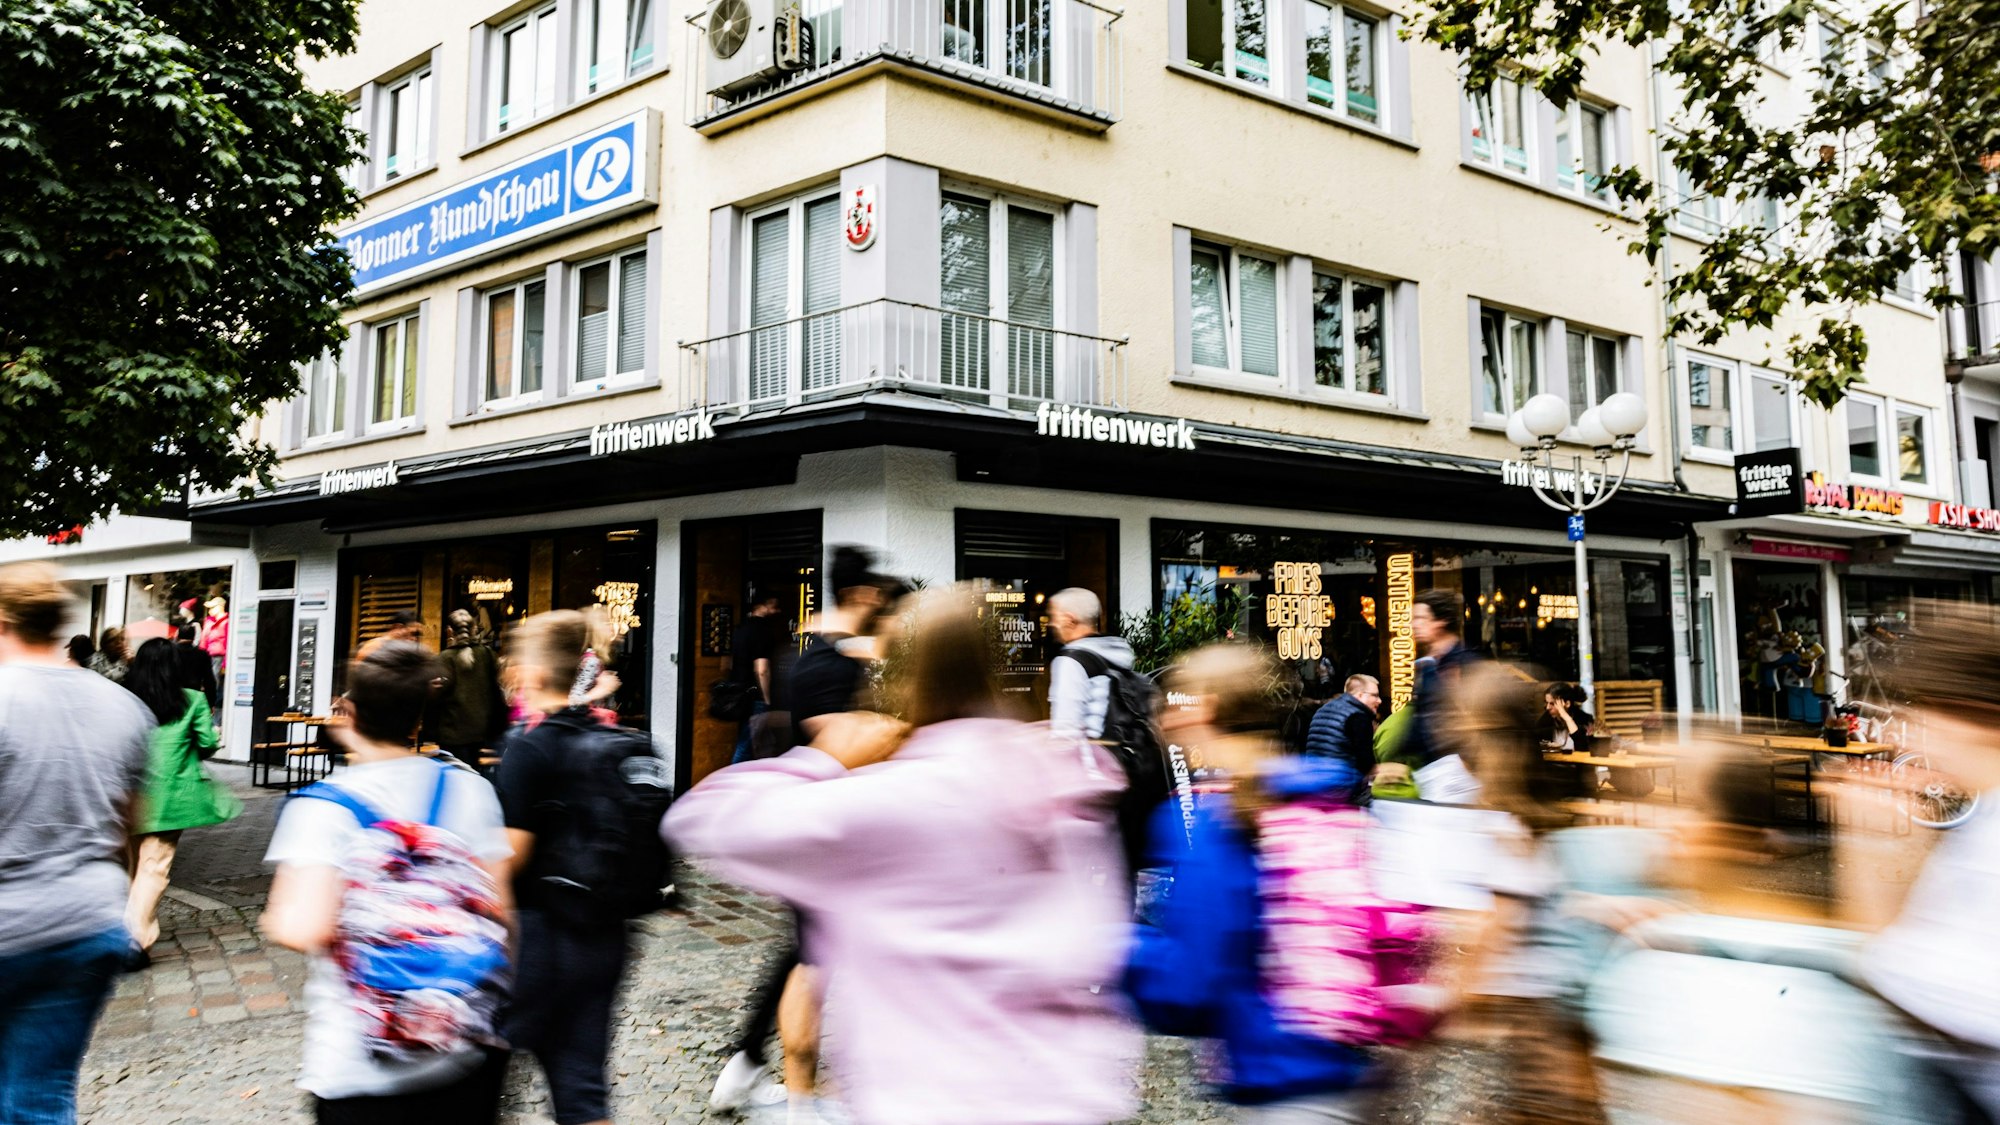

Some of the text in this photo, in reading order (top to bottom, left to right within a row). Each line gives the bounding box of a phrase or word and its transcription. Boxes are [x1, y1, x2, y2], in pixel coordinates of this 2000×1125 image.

[590, 407, 715, 456] frittenwerk
[1036, 402, 1195, 450] frittenwerk
[319, 460, 398, 496] frittenwerk
[1739, 464, 1793, 482] fritten
[1745, 475, 1790, 493] werk
[1804, 479, 1851, 508] ROYAL
[1853, 485, 1904, 515] DONUTS
[1938, 501, 1971, 527] ASIA
[1274, 561, 1322, 594] FRIES
[986, 593, 1025, 602] ORDER HERE
[1266, 594, 1331, 627] BEFORE
[1002, 628, 1032, 642] werk
[1277, 627, 1322, 660] GUYS
